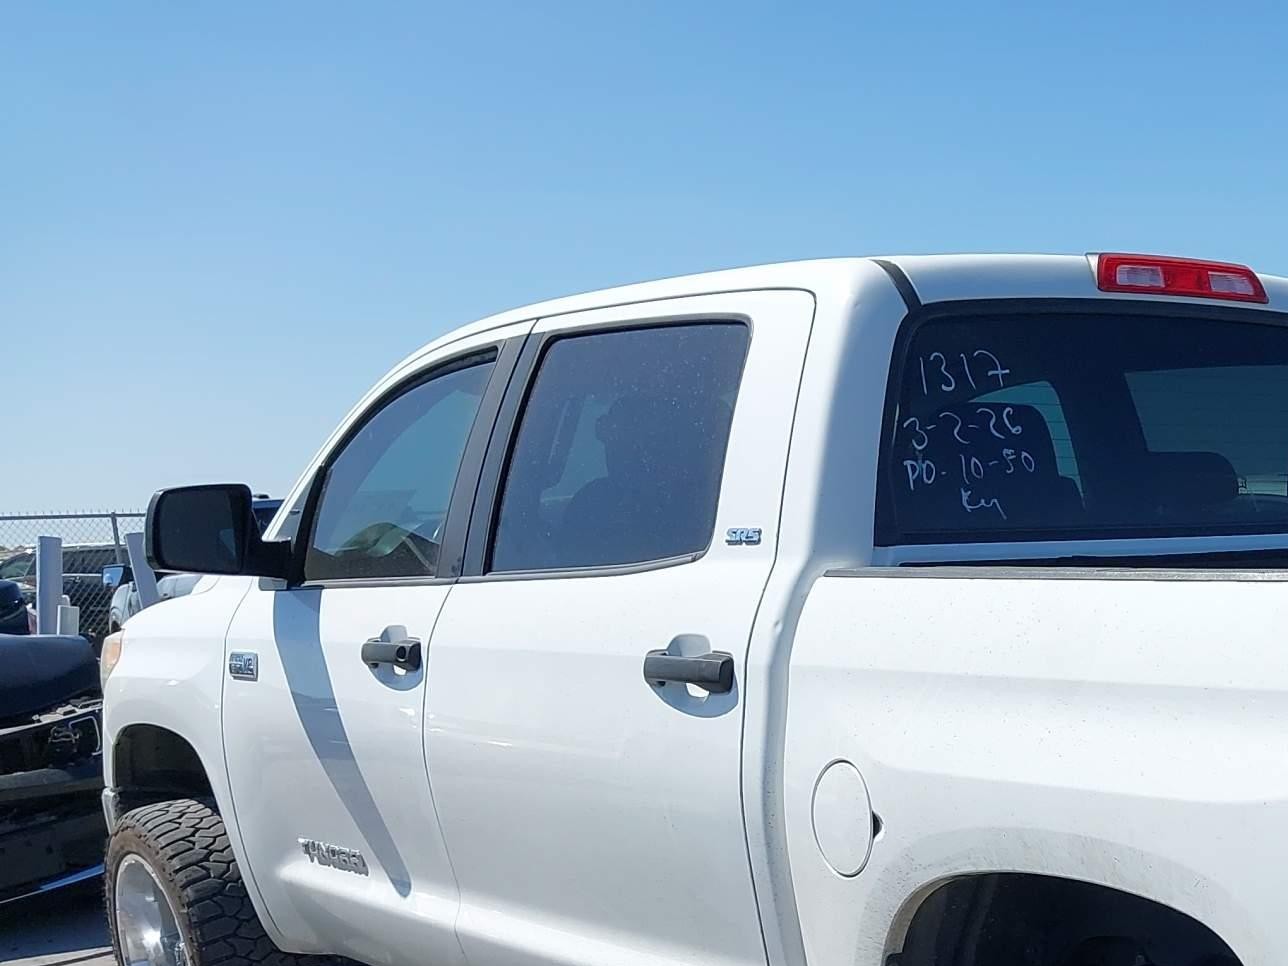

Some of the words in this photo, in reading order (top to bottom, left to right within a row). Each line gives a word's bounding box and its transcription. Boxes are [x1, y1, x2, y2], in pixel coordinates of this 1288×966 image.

[918, 350, 1010, 396] 1317
[903, 407, 1022, 450] 3-2-26
[725, 528, 763, 546] SR5
